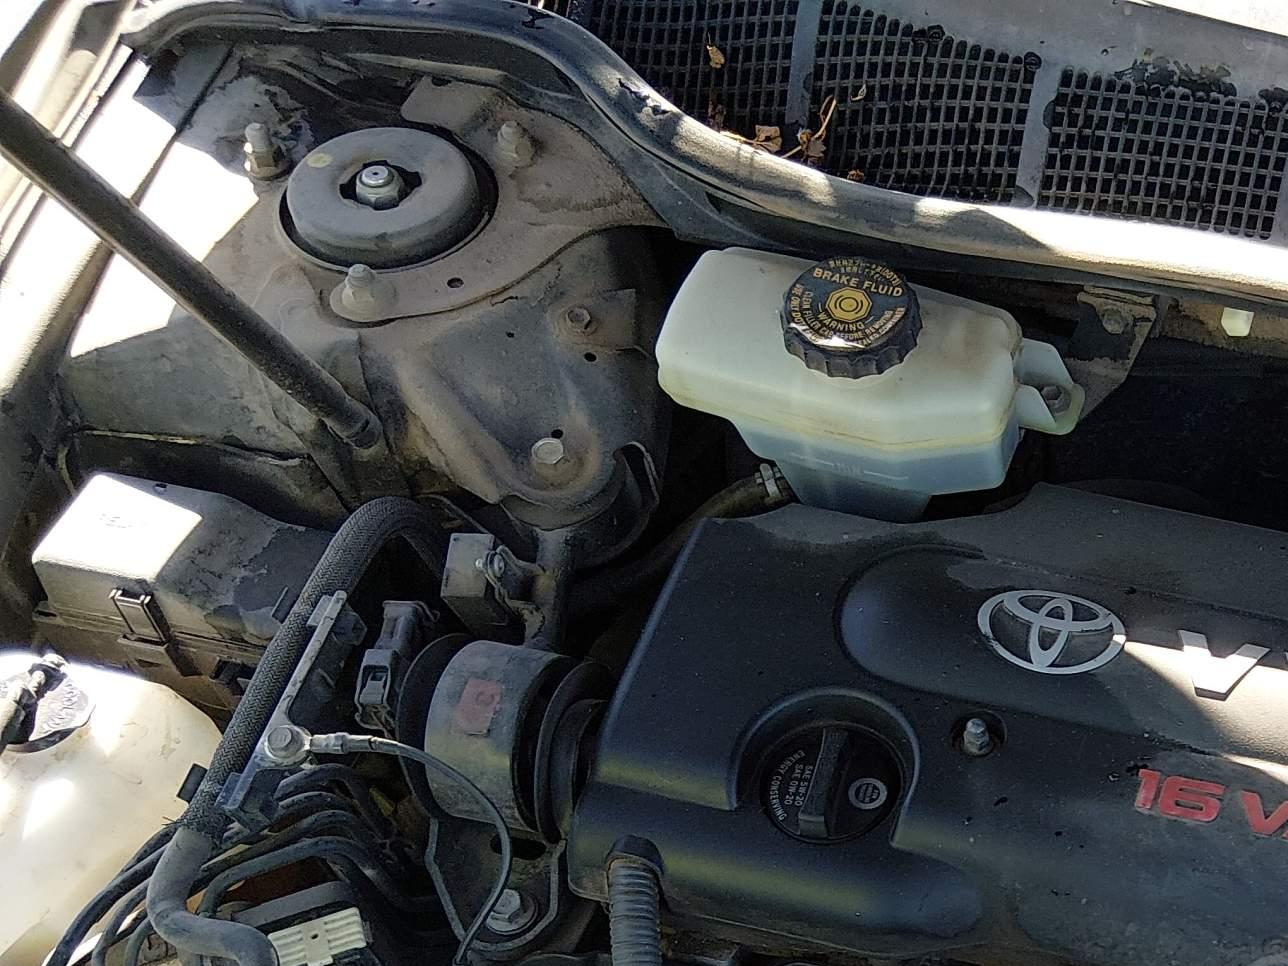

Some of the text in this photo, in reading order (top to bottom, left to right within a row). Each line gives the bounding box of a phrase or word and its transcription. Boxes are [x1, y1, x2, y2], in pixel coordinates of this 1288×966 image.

[813, 267, 860, 288] BRAKE
[862, 281, 903, 297] FLUID
[817, 312, 865, 331] WARNING
[770, 750, 805, 821] ENERGY CONSERVING
[791, 764, 804, 779] SAE
[795, 765, 813, 807] SAE 5W-20
[1135, 769, 1225, 822] 16
